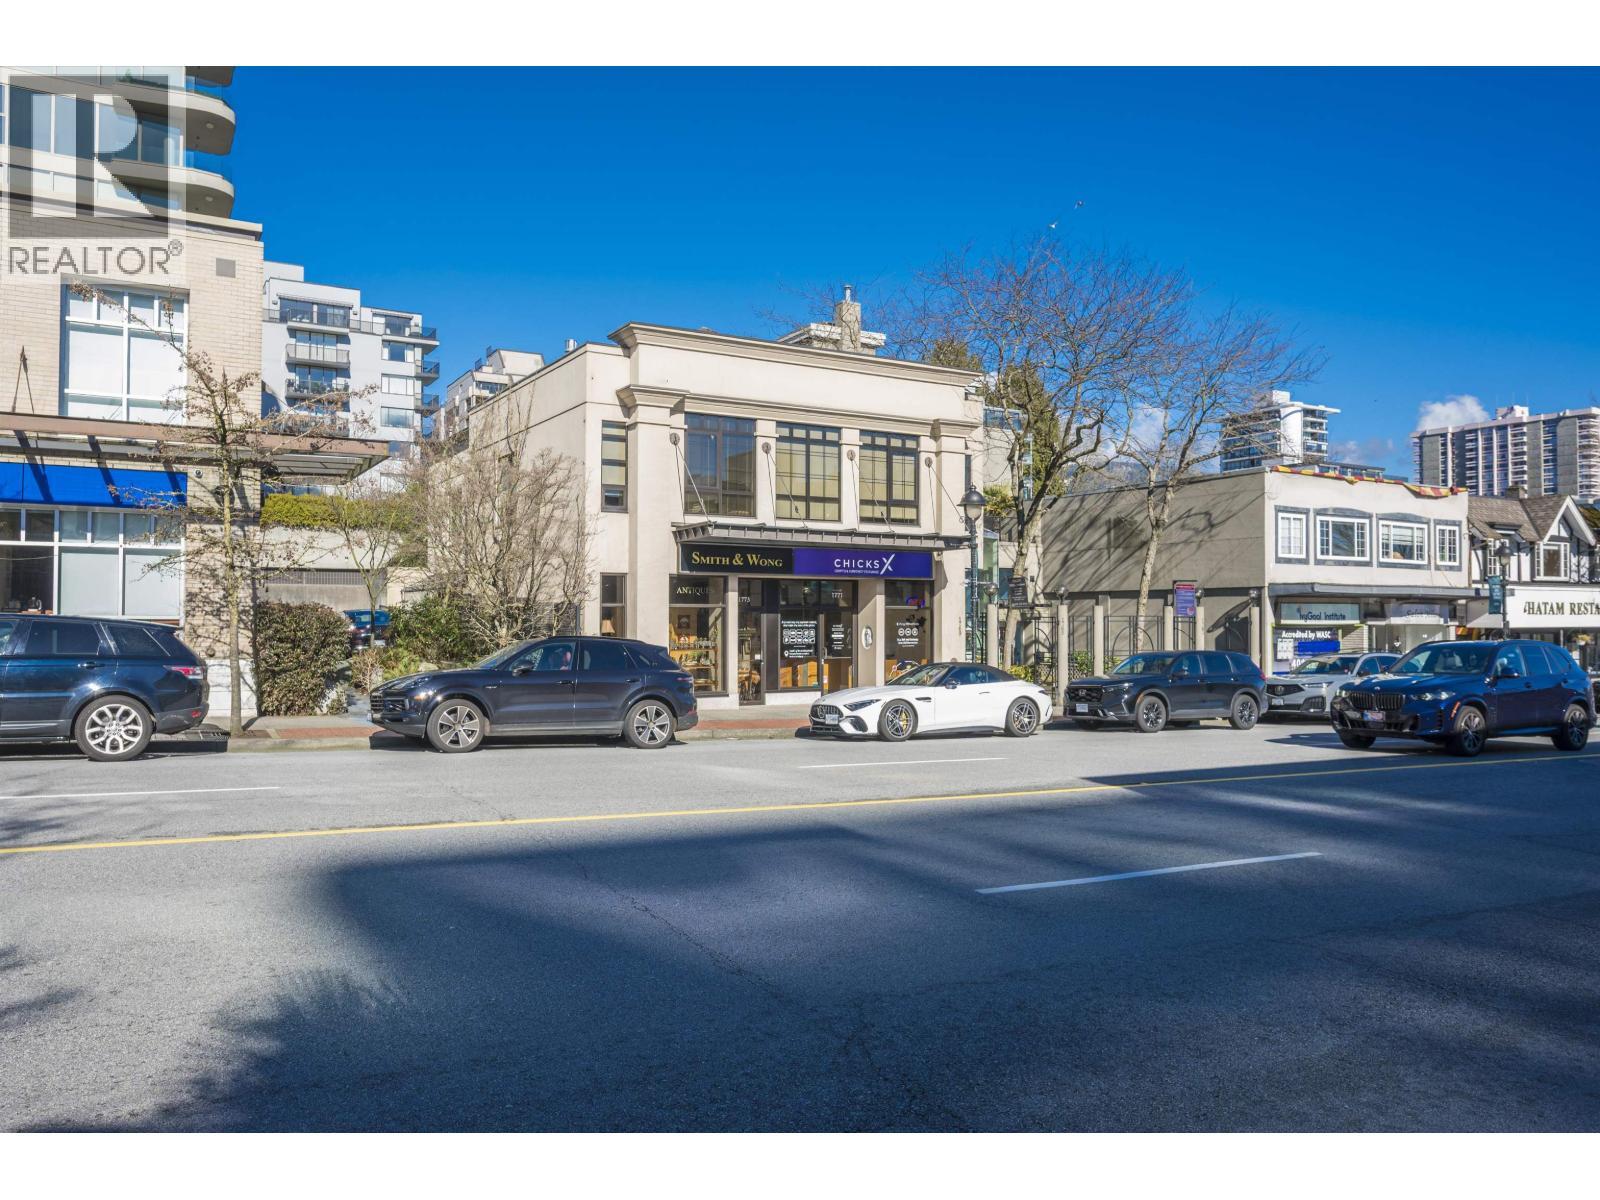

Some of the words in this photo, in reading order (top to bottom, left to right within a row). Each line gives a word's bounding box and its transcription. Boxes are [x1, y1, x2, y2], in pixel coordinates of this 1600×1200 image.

[732, 554, 744, 566] &
[1524, 601, 1565, 616] HATAM
[1324, 611, 1346, 621] Institute
[1281, 629, 1308, 639] Accredited
[1308, 630, 1316, 640] by
